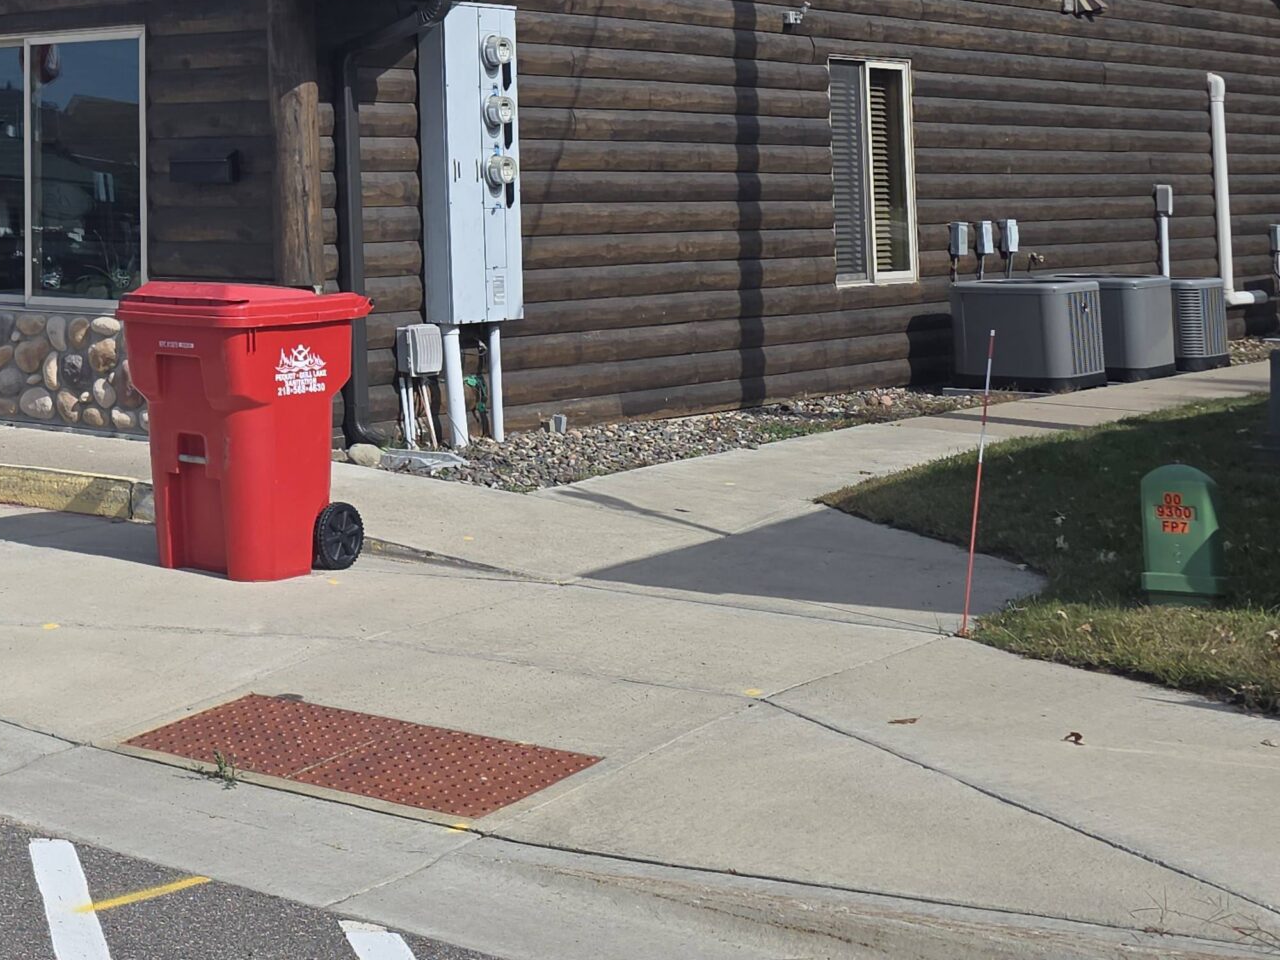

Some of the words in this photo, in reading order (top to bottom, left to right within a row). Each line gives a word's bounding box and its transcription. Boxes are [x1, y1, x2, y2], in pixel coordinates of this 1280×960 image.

[1164, 493, 1181, 505] 00
[1156, 505, 1191, 518] 9300
[1162, 520, 1187, 533] FP7
